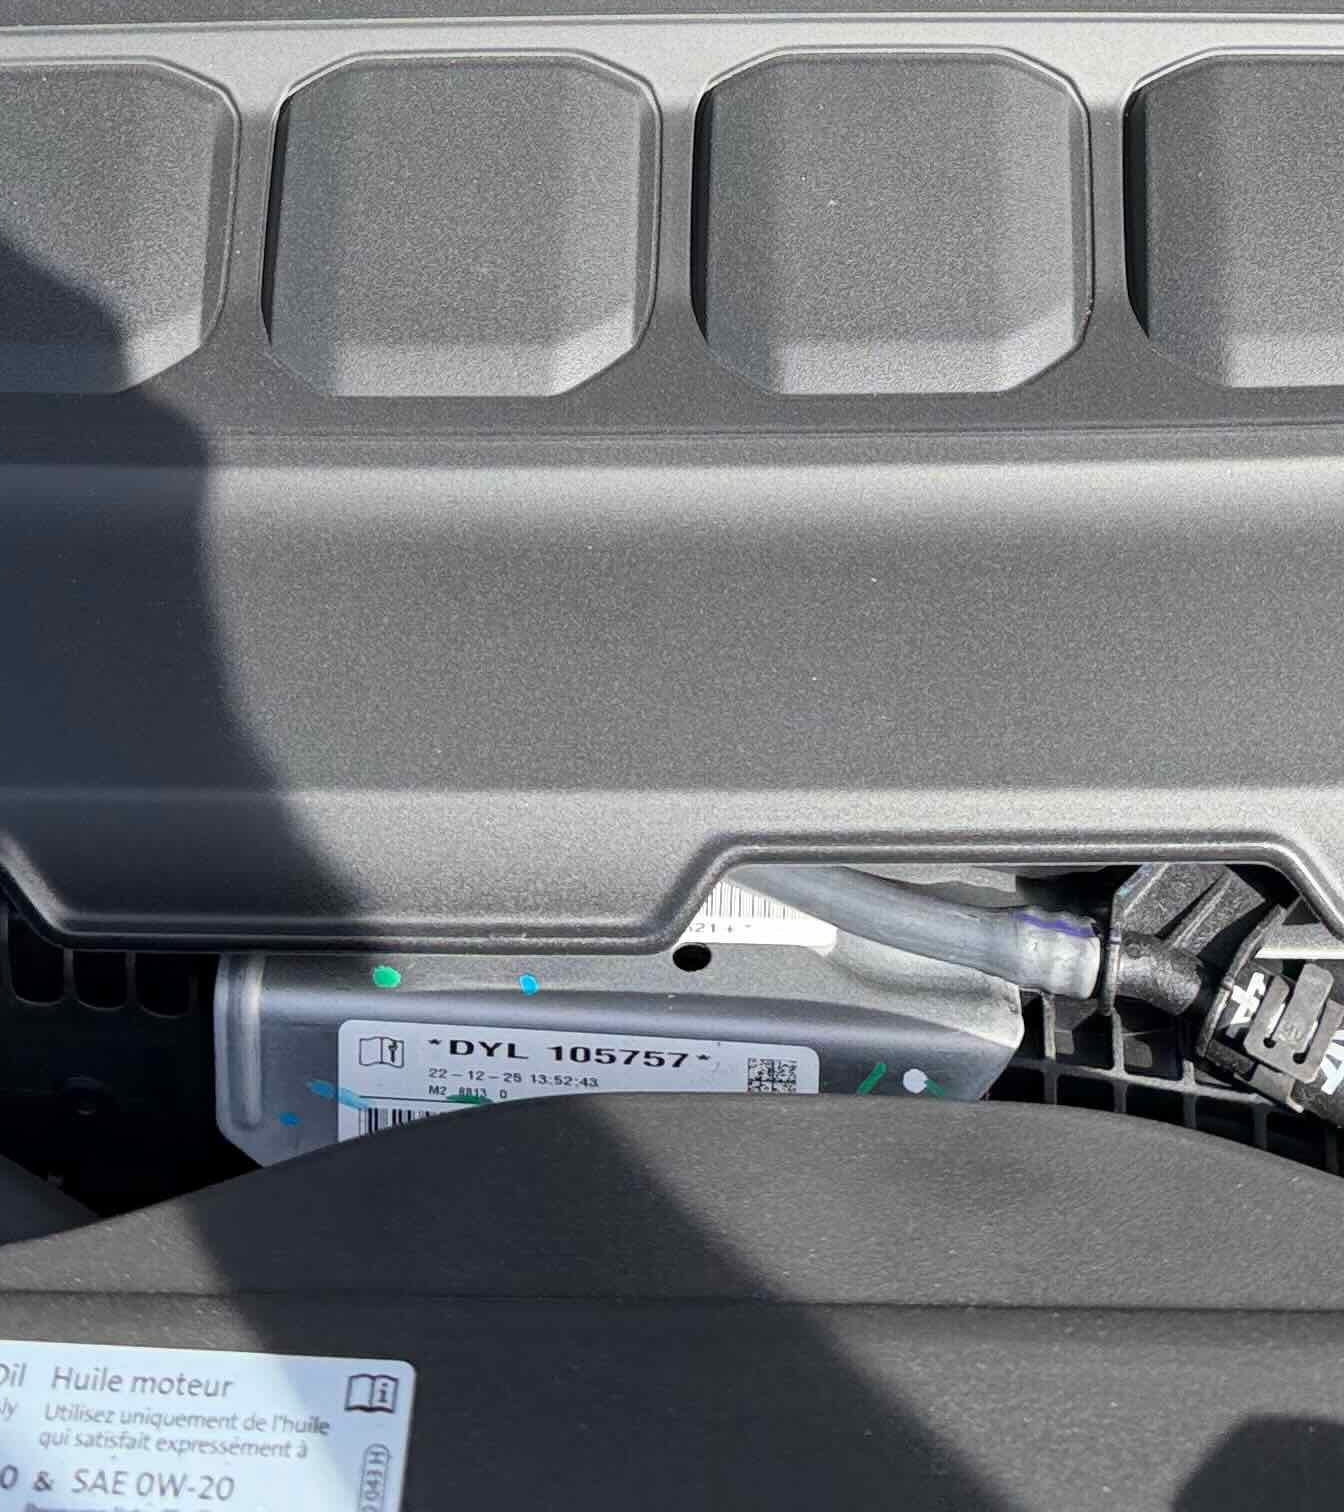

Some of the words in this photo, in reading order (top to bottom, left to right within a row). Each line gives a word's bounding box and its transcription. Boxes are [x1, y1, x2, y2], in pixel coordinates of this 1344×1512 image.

[51, 1365, 124, 1394] Huile
[130, 1373, 234, 1398] moteur
[44, 1402, 115, 1427] Utilisez
[118, 1407, 238, 1433] uniquement
[242, 1410, 268, 1432] de
[271, 1413, 331, 1437] l'huile
[39, 1429, 70, 1450] qui
[74, 1429, 151, 1451] satisfait
[156, 1434, 292, 1460] expressément
[296, 1440, 308, 1459] à
[32, 1470, 55, 1493] &
[71, 1467, 129, 1495] SAE
[135, 1471, 236, 1502] 0W-20
